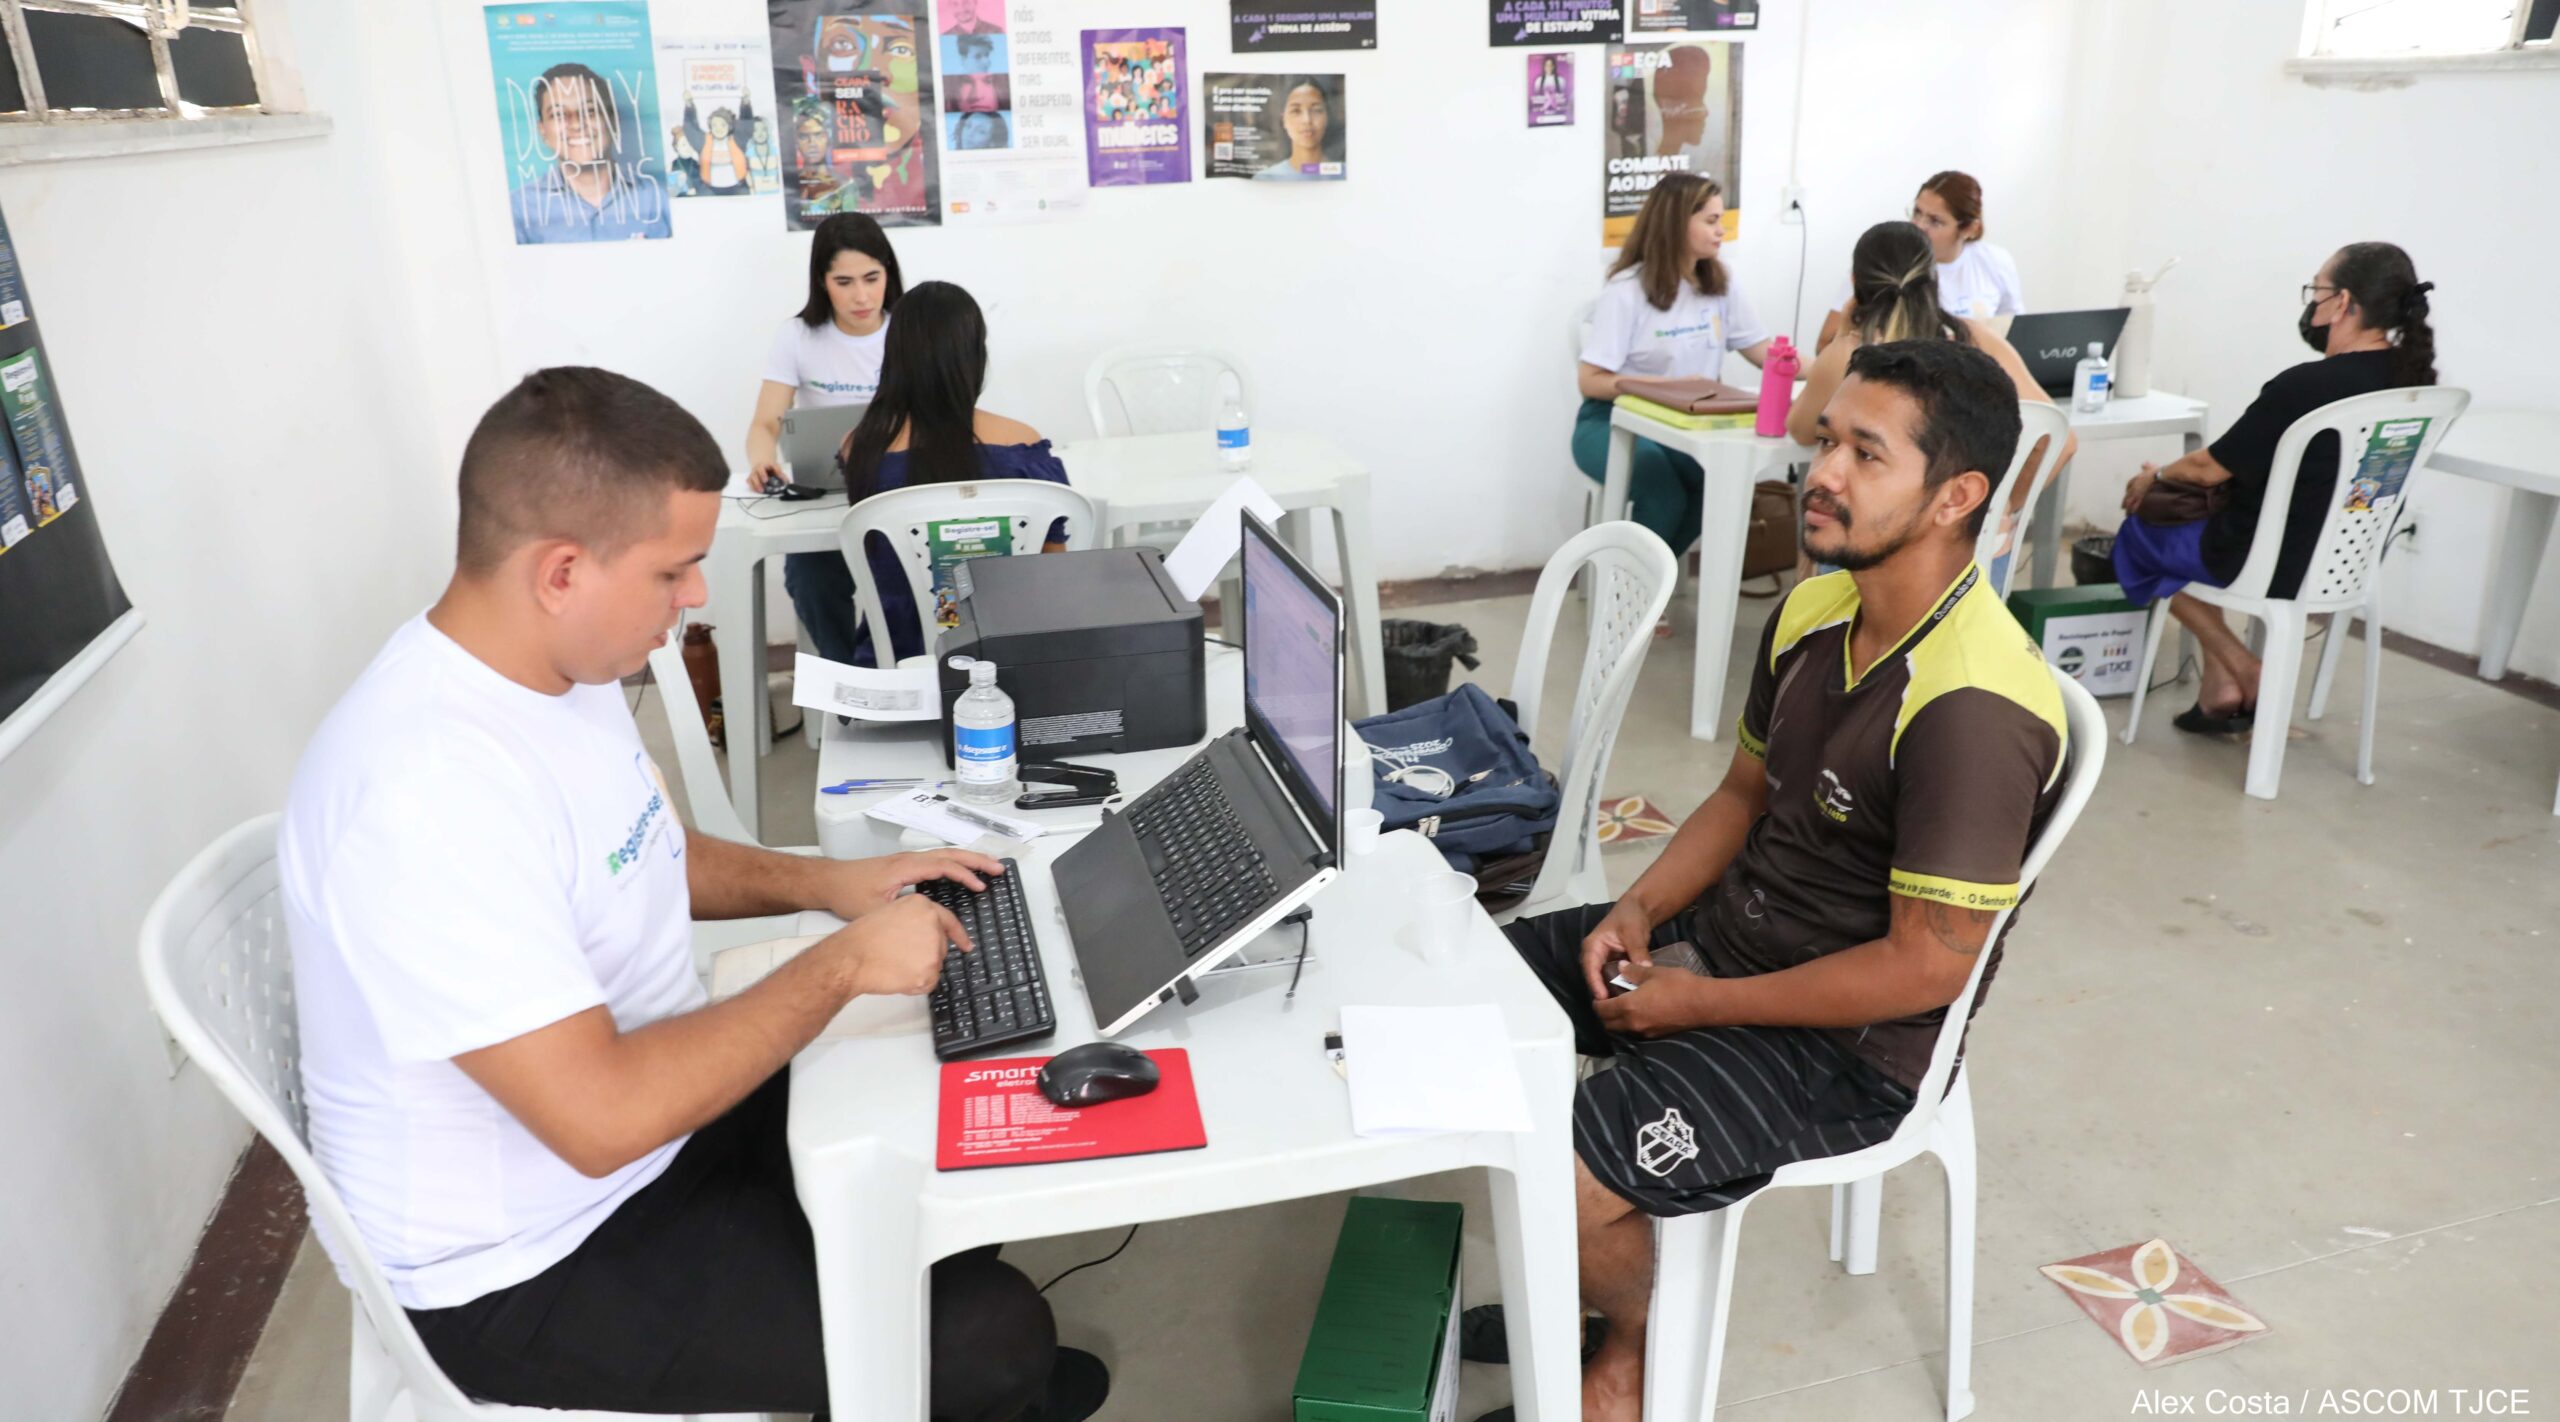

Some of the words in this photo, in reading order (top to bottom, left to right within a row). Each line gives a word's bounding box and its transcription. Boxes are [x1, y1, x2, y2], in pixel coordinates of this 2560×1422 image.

[835, 87, 863, 98] SEM
[1608, 155, 1690, 174] COMBATE
[1608, 175, 1634, 192] AO
[2040, 346, 2078, 359] VAIO
